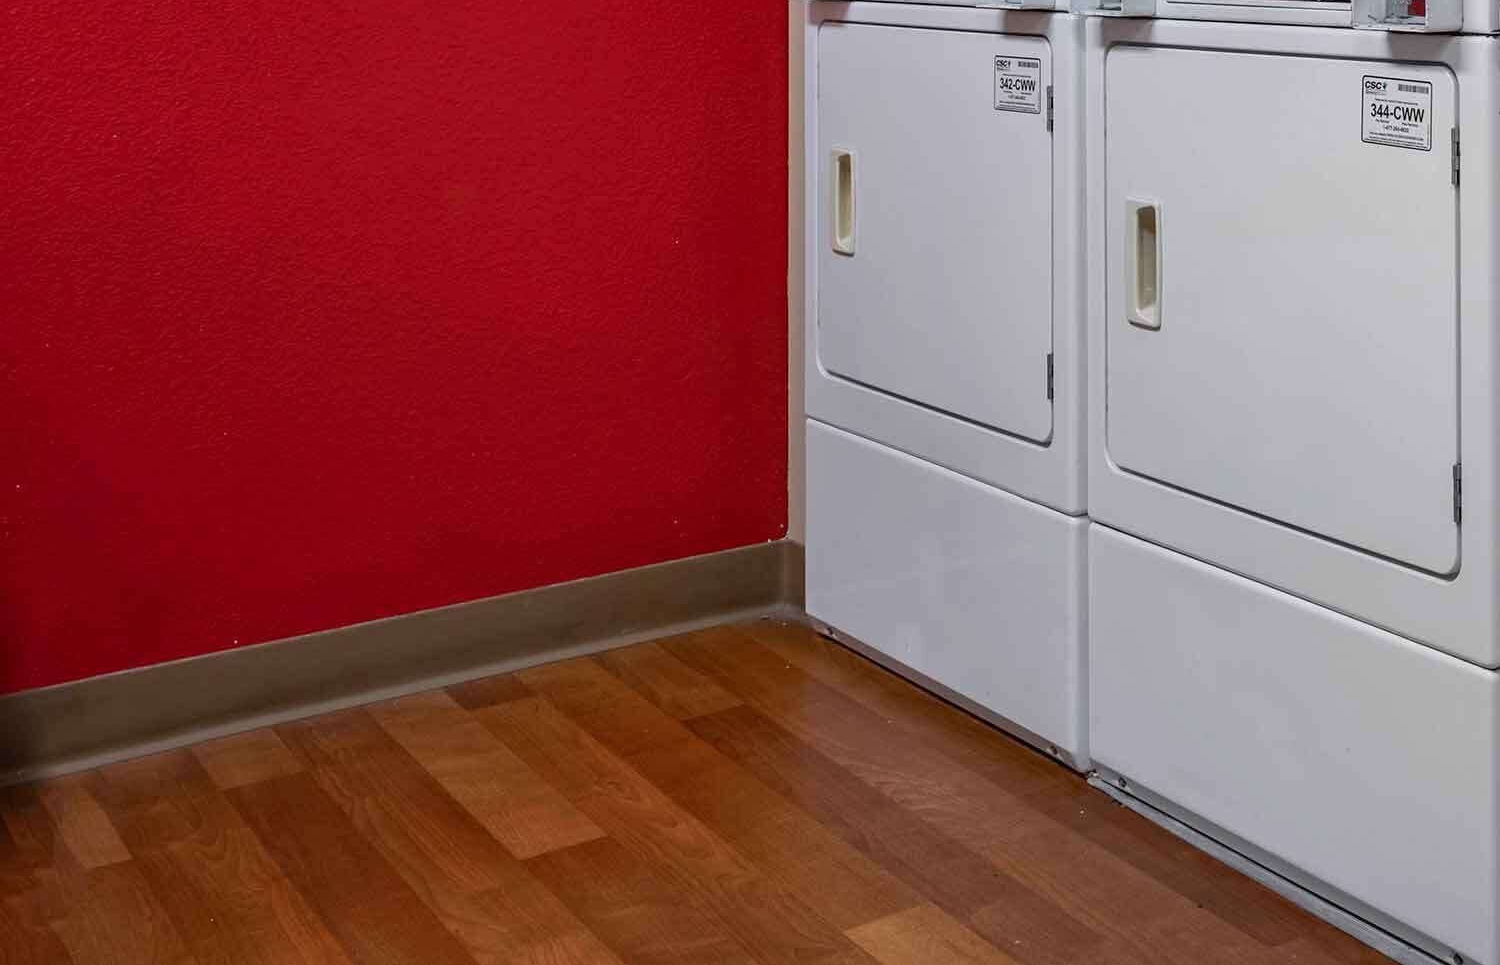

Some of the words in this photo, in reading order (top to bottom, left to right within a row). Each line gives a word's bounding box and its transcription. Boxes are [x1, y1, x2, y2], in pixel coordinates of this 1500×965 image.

[1000, 78, 1035, 92] 342-CWW
[1365, 81, 1381, 90] CSC
[1371, 103, 1424, 123] 344-CWW
